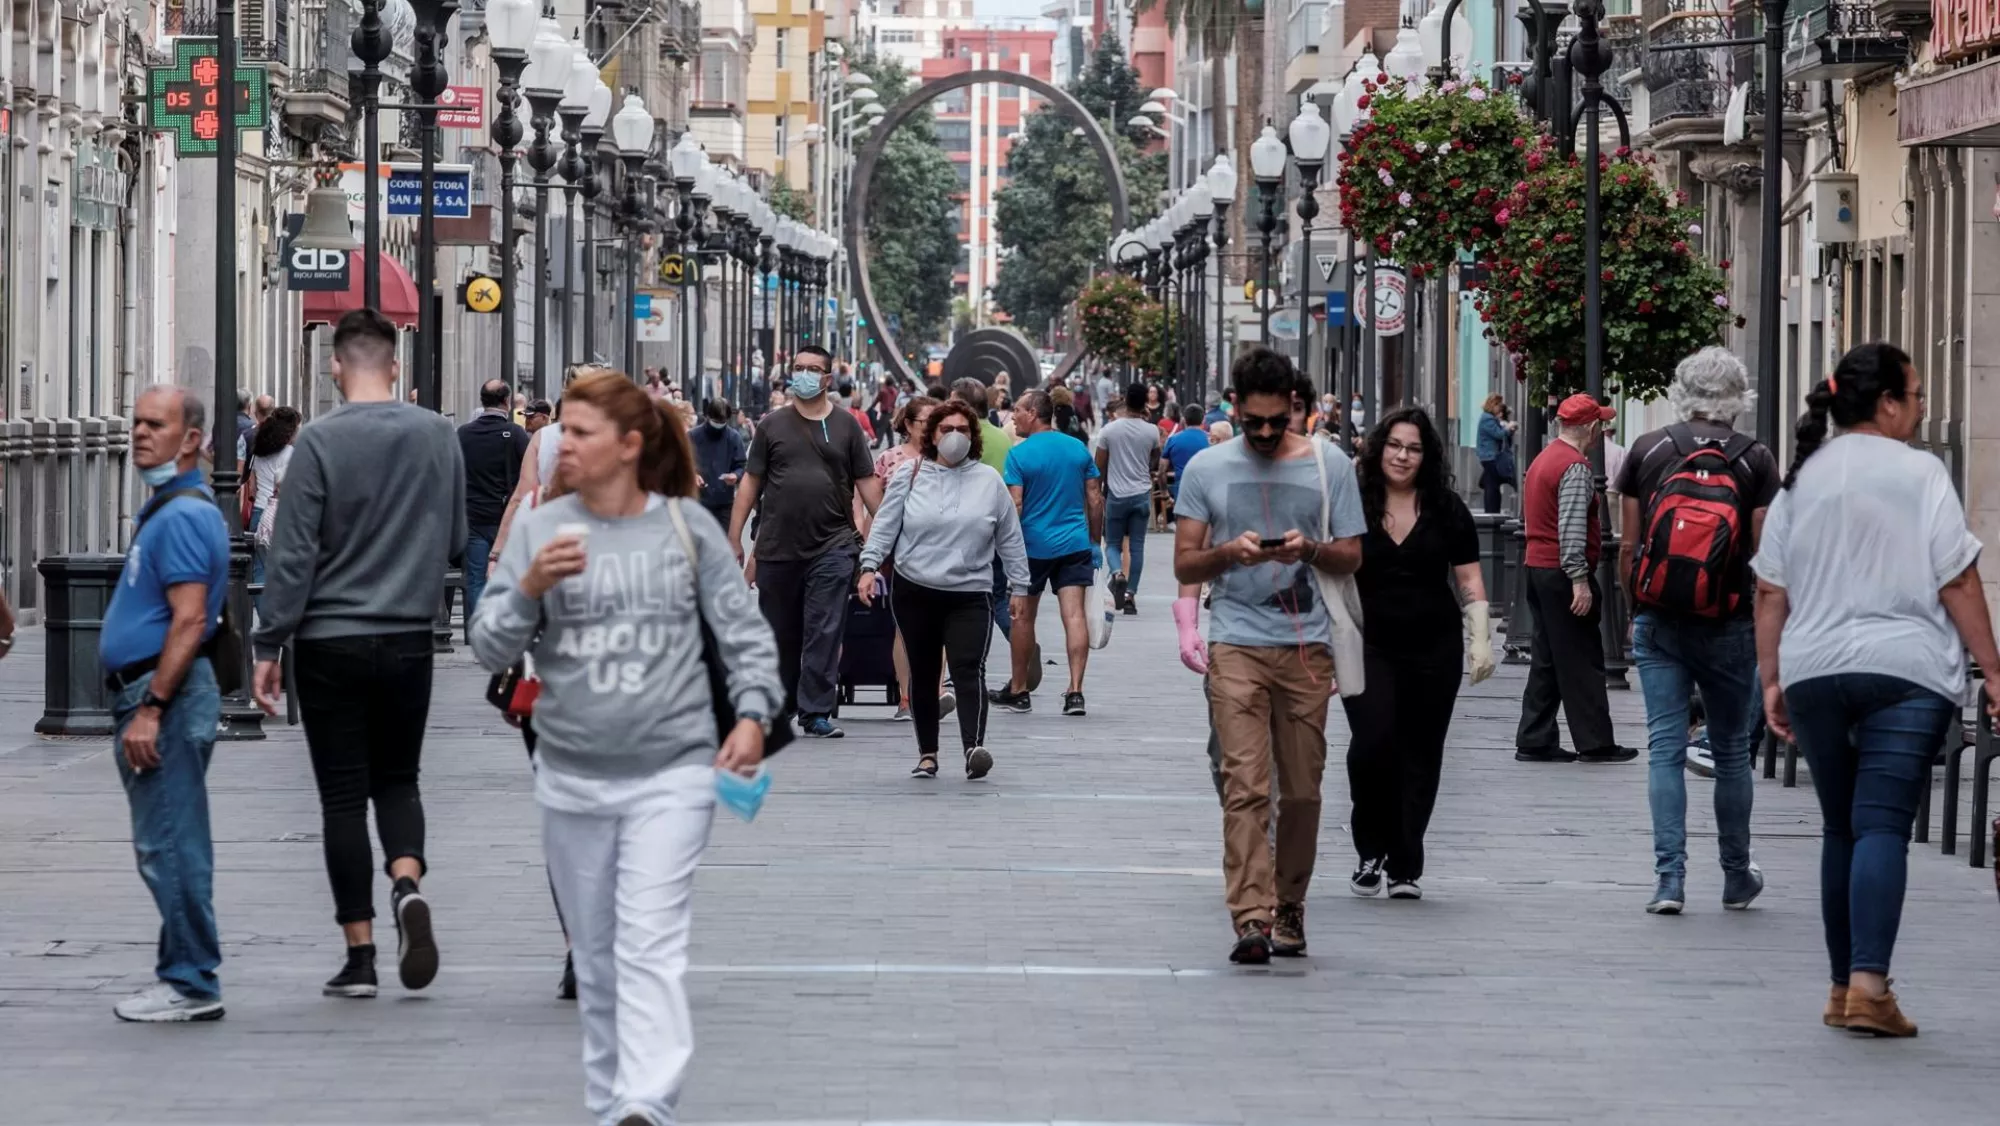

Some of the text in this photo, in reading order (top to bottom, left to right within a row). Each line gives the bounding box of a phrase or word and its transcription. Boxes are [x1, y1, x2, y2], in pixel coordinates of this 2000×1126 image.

[390, 180, 465, 190] CONSTCTORA
[389, 194, 411, 205] SAN
[413, 193, 443, 208] JÉ,
[556, 623, 683, 658] ABOUT
[588, 660, 646, 693] US
